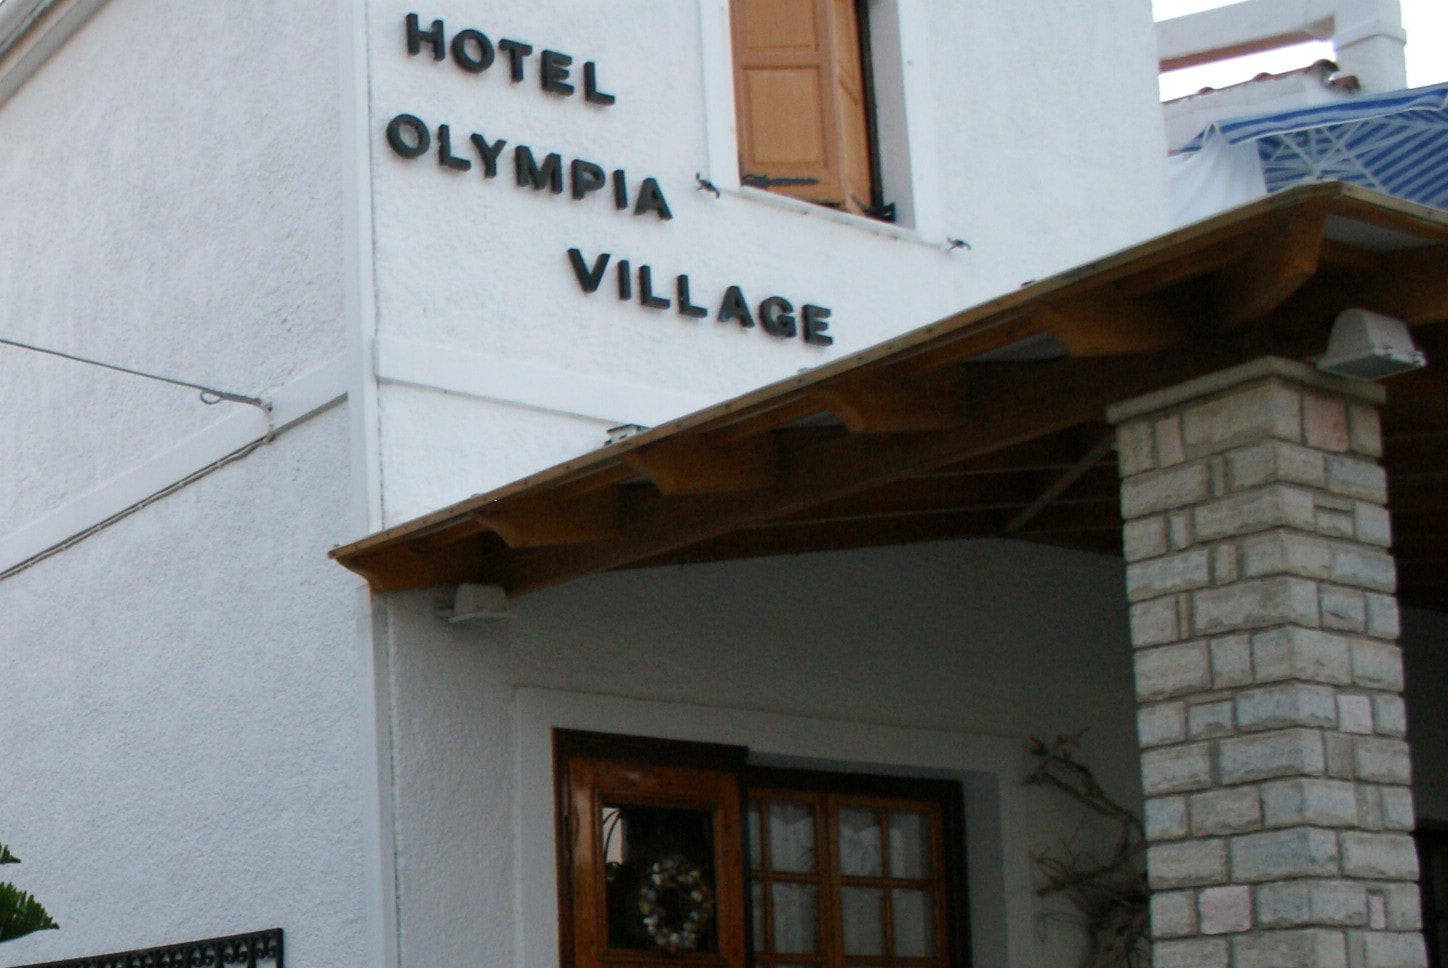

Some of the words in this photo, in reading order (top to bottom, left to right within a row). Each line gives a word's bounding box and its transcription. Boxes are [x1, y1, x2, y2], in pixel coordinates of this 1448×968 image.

[405, 12, 616, 106] HOTEL
[385, 113, 673, 220] OLYMPIA
[567, 248, 833, 346] VILLAGE
